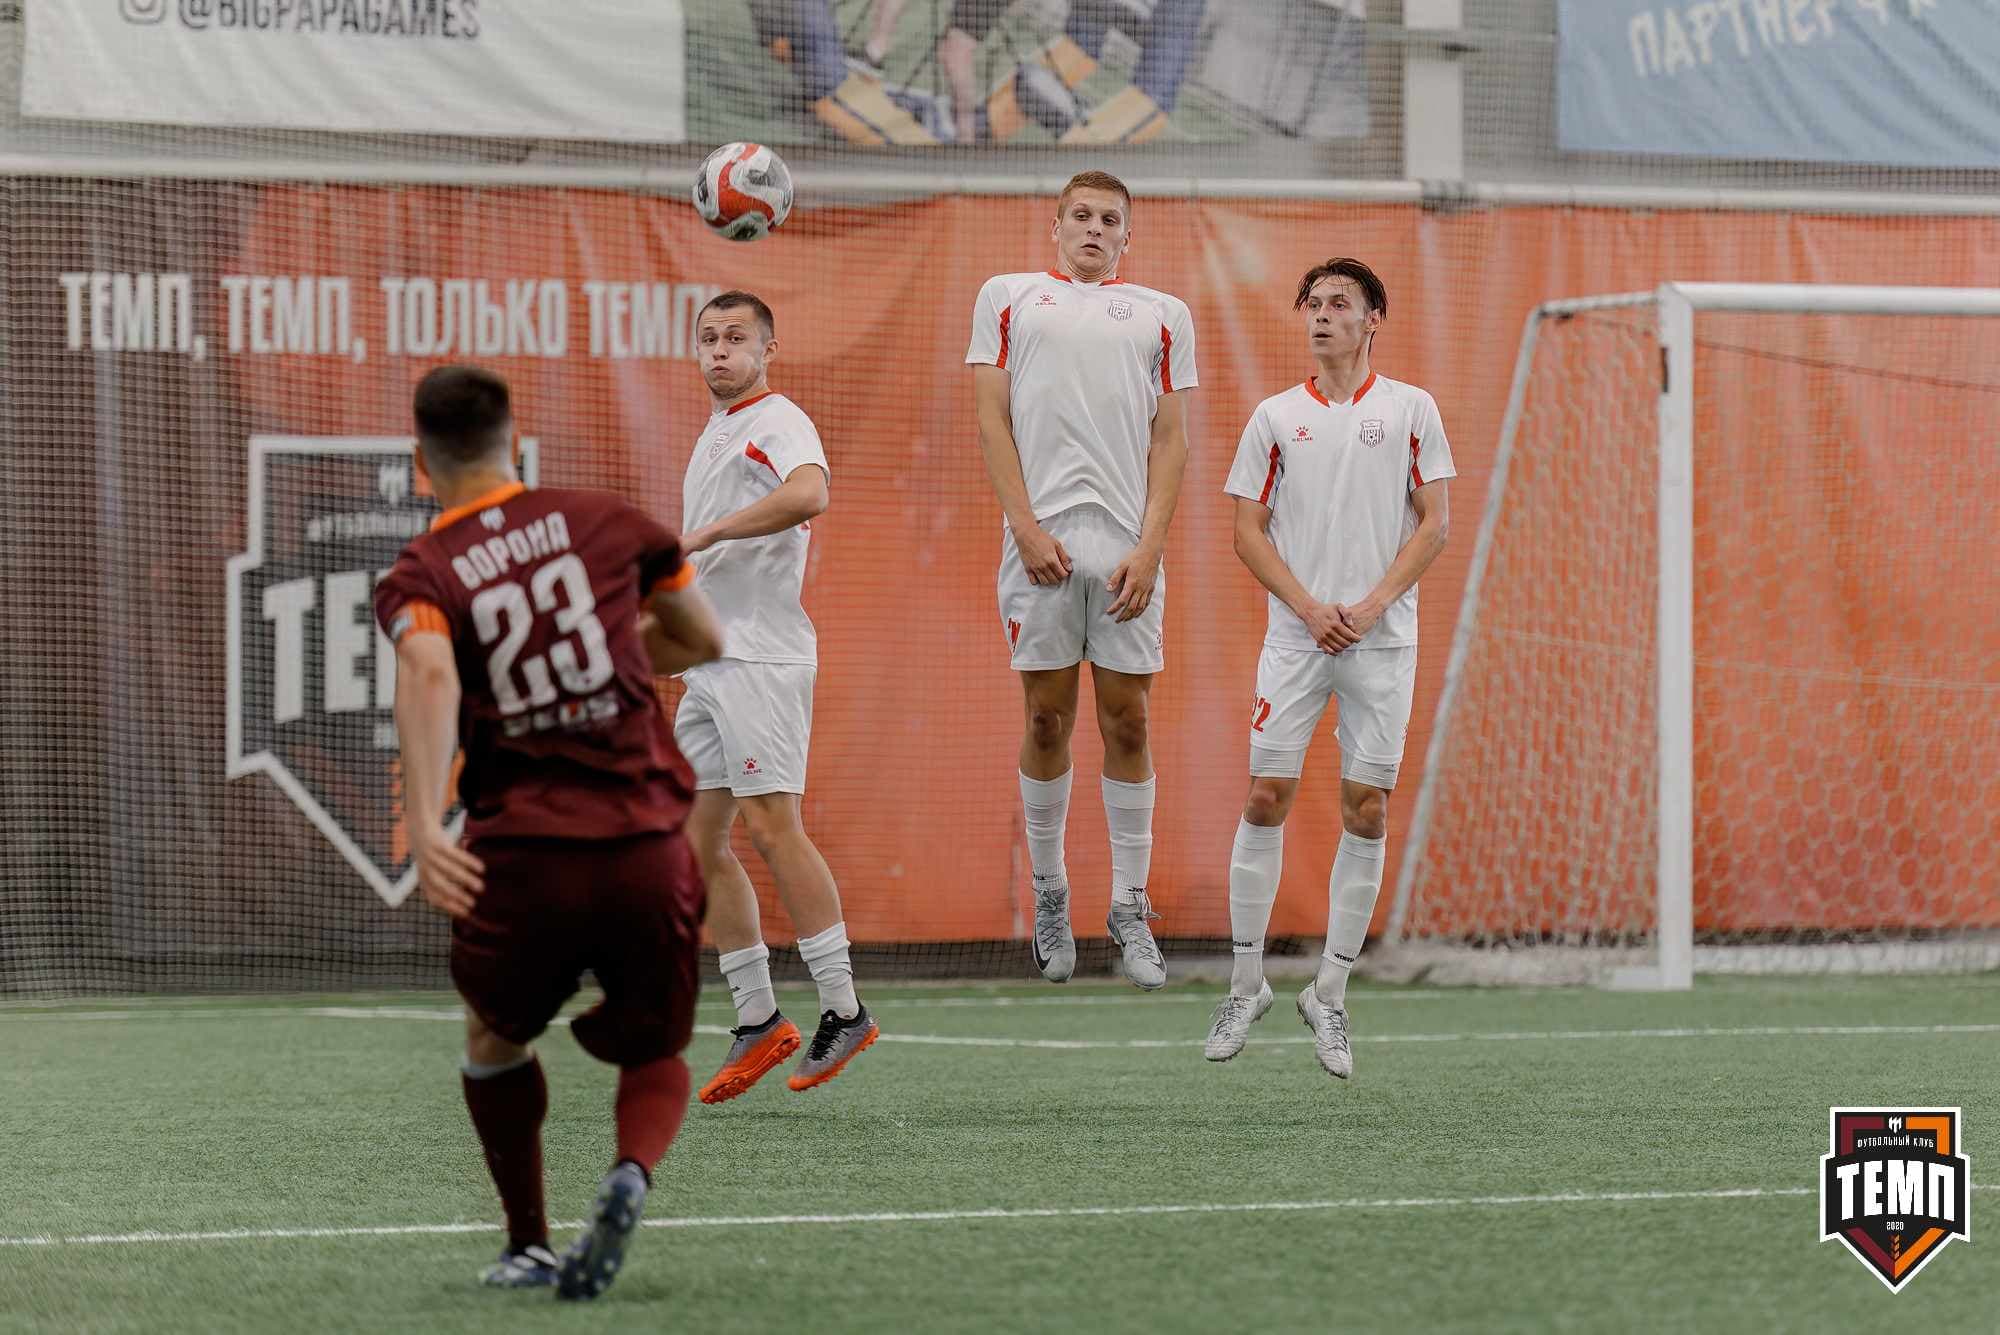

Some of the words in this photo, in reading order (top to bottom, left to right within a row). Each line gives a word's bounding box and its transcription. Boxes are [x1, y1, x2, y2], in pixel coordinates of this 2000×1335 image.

[60, 272, 206, 361] ТЕМП,
[219, 275, 366, 363] ТЕМП,
[380, 277, 567, 358] ТОЛЬКО
[583, 280, 720, 358] ТЕМП
[262, 568, 397, 725] ТЕ
[471, 552, 615, 715] 23
